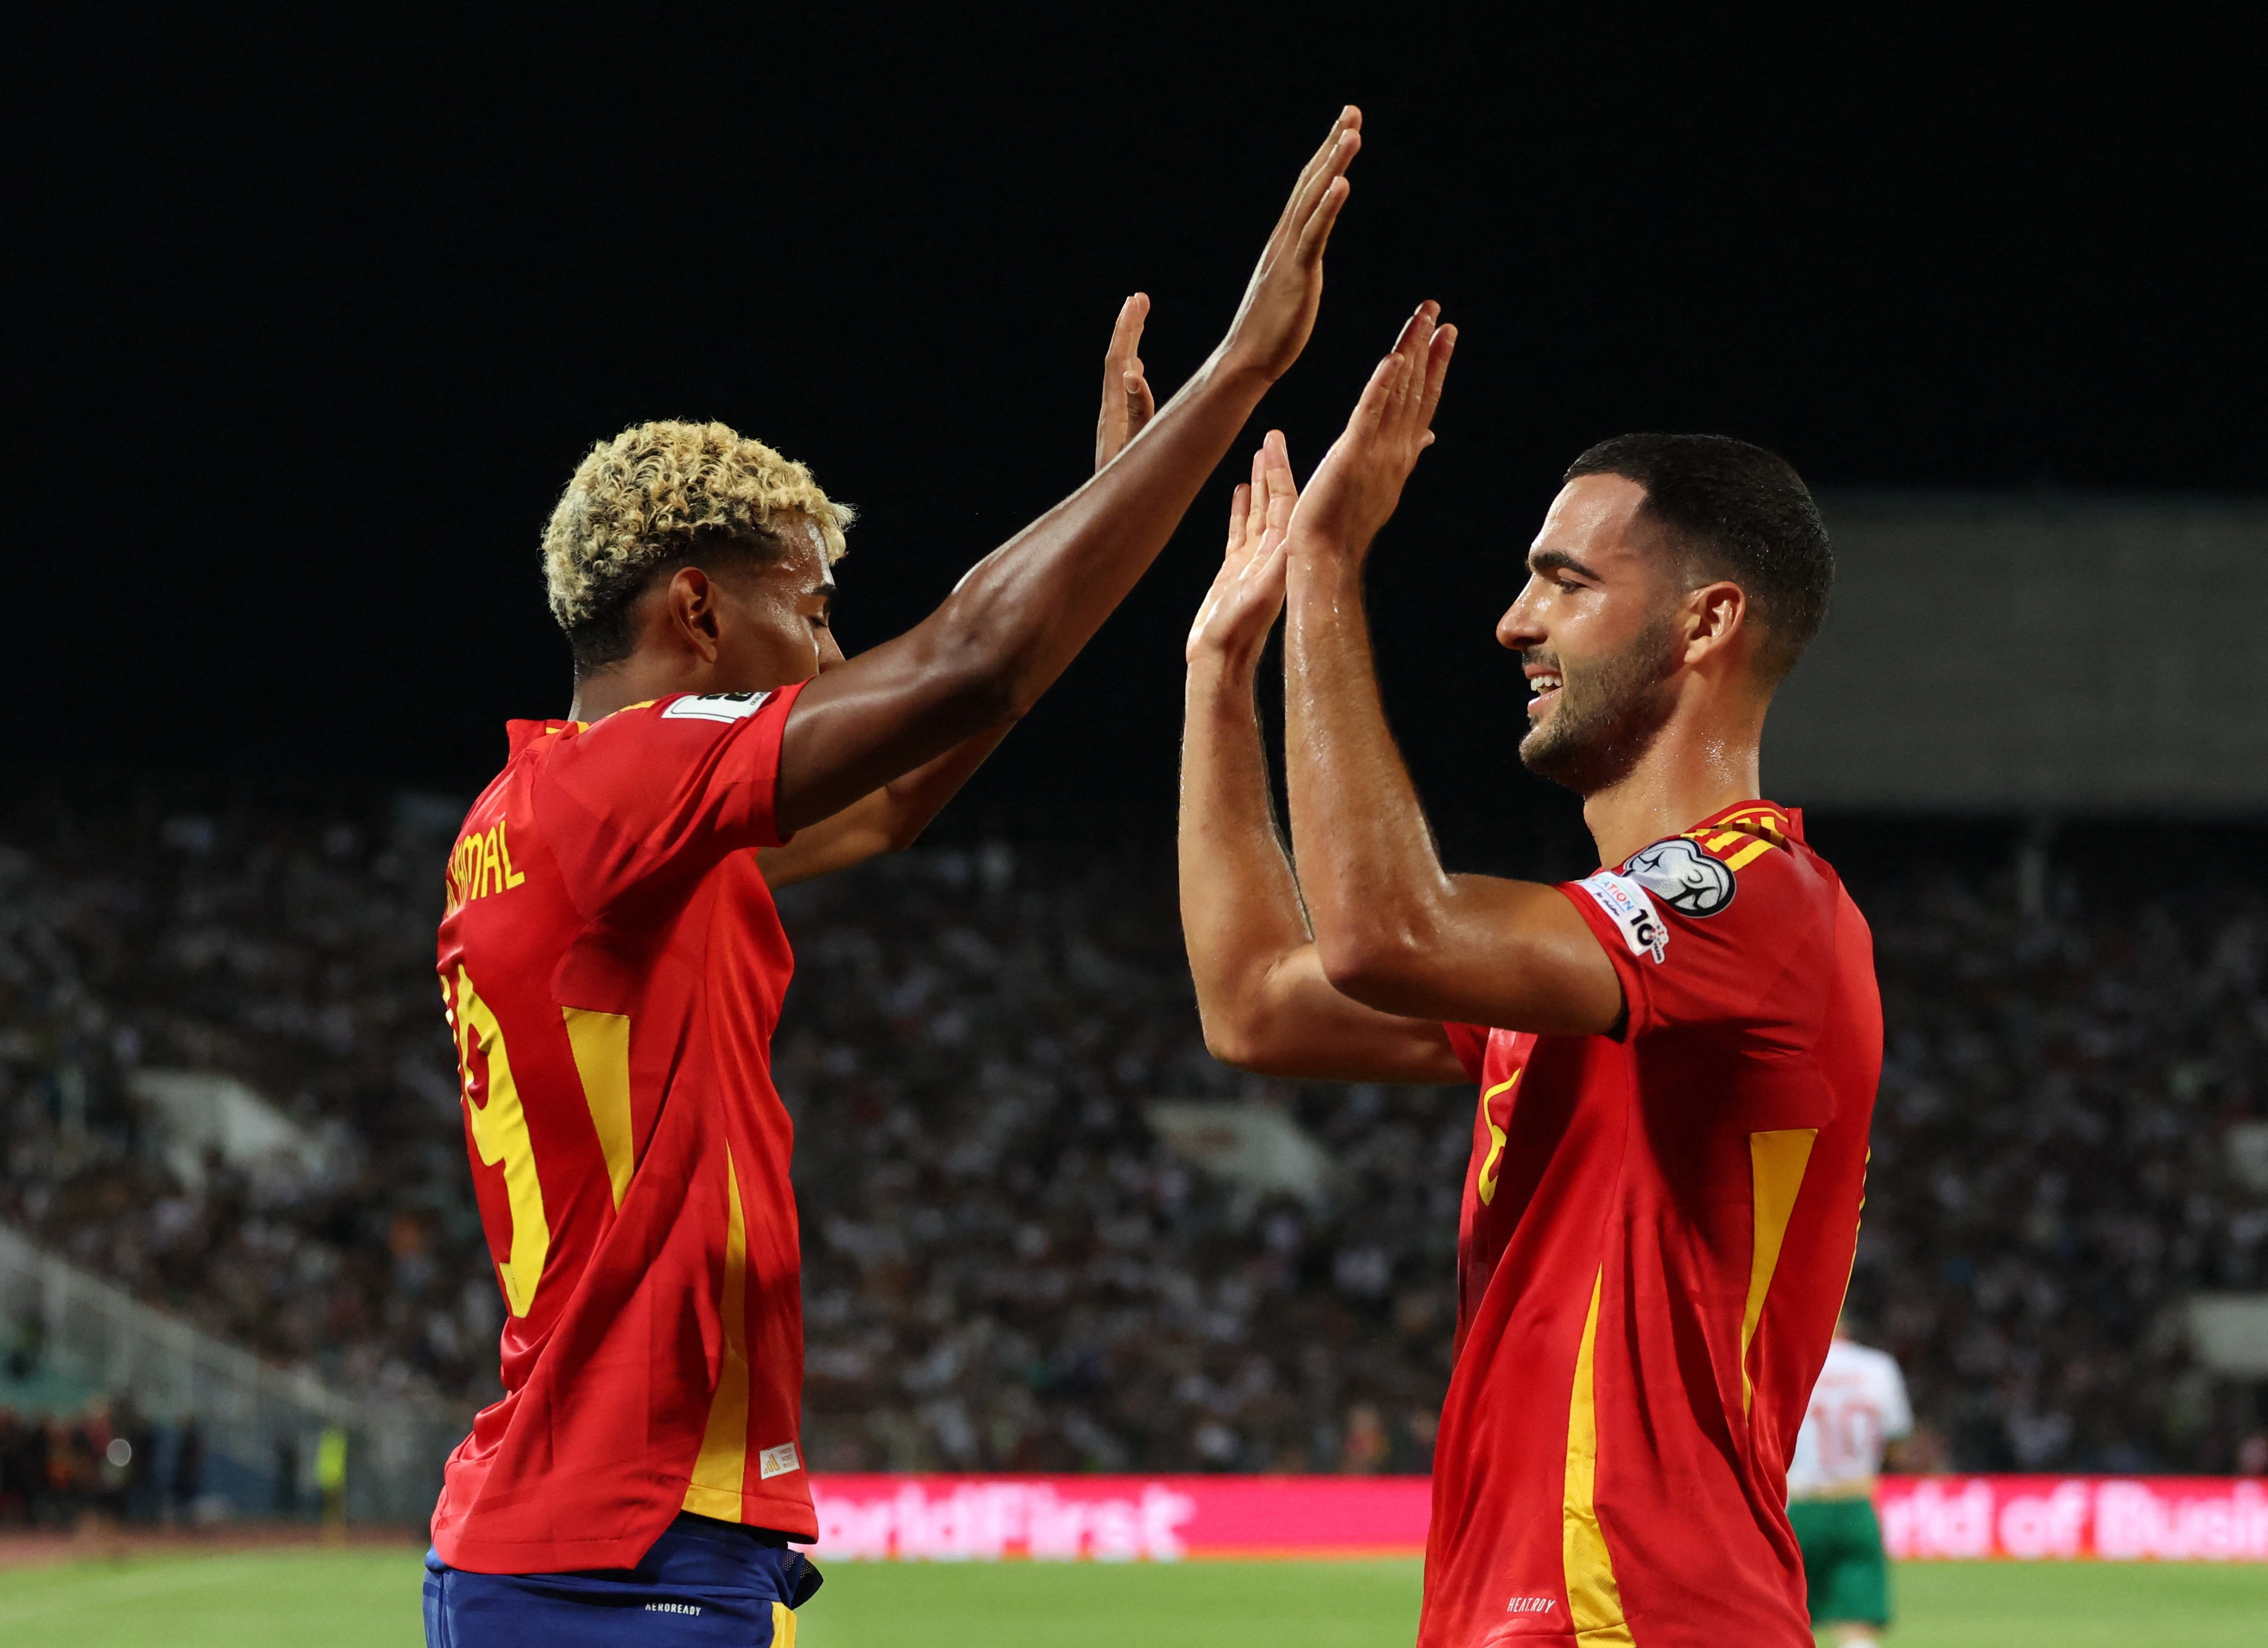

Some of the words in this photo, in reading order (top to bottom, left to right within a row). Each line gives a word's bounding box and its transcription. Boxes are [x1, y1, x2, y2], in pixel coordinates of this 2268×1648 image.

[441, 964, 550, 1319] 9
[1809, 1398, 1884, 1472] 10
[808, 1481, 1196, 1560] orldFirst
[2000, 1478, 2088, 1560] of
[645, 1602, 701, 1616] AEROREADY
